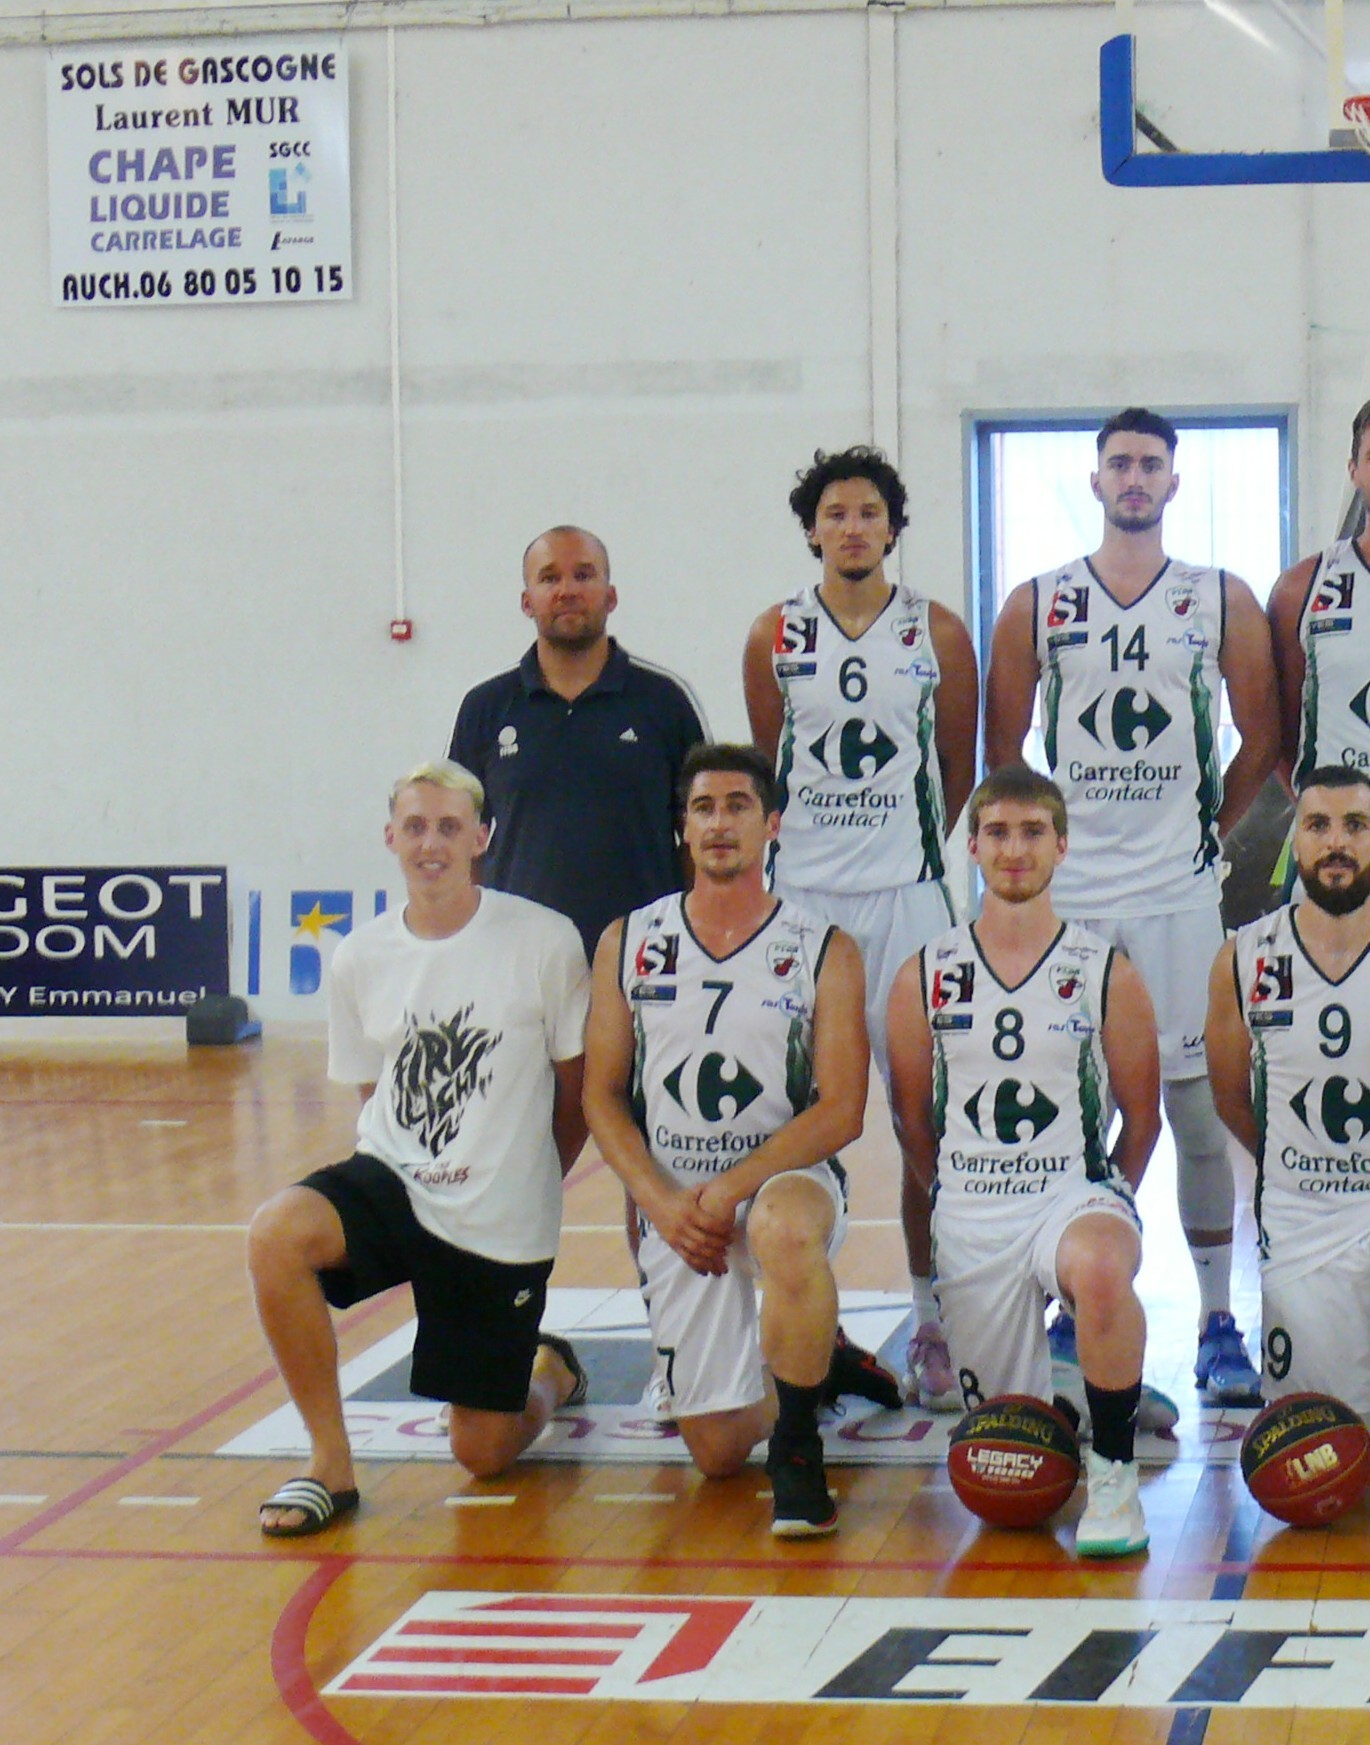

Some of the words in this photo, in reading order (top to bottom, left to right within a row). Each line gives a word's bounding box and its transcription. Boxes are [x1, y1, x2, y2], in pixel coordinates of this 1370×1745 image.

[61, 62, 124, 91] SOLS
[134, 59, 167, 87] DE
[178, 53, 336, 85] GASCOGNE
[95, 102, 213, 131] Laurent
[226, 96, 300, 125] MUR
[88, 144, 236, 184] CHAPE
[269, 141, 310, 158] SGCC
[90, 190, 230, 223] LIQUIDE
[90, 226, 242, 252] CARRELAGE
[184, 269, 216, 296] 80
[225, 267, 257, 295] 05
[272, 265, 302, 294] 10
[314, 265, 343, 293] 15
[1101, 624, 1149, 671] 14
[839, 656, 868, 703] 6
[1069, 760, 1181, 782] Carrefour
[798, 786, 904, 809] Carrefou
[1085, 784, 1165, 801] contact
[813, 812, 888, 829] contact
[28, 986, 206, 1008] Emmanuel
[702, 980, 734, 1035] 7
[992, 1007, 1025, 1061] 8
[1319, 1003, 1352, 1059] 9
[672, 1154, 744, 1173] conta
[951, 1151, 1070, 1175] Carrefour
[964, 1175, 1050, 1195] contact
[1267, 1326, 1292, 1381] 9
[657, 1347, 675, 1396] 7
[959, 1367, 986, 1411] 8
[967, 1447, 1043, 1469] LEGACY
